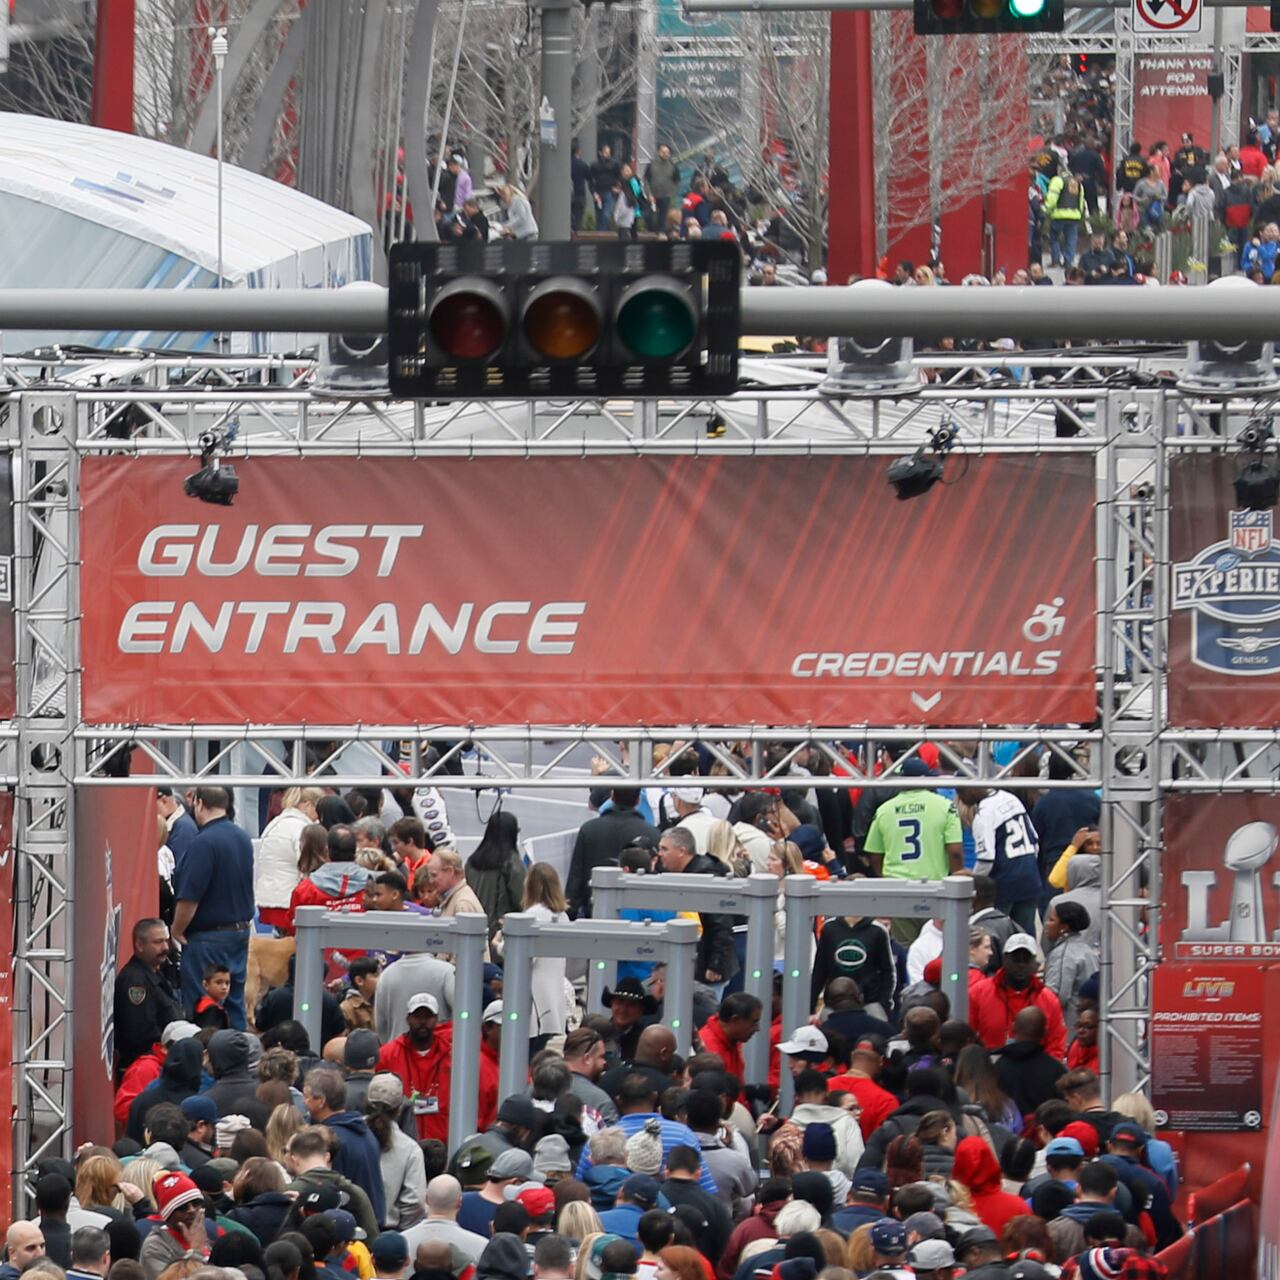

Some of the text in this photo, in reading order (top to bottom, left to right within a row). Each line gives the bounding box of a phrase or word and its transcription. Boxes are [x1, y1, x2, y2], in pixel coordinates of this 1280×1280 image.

[1140, 59, 1186, 69] THANK
[1165, 72, 1196, 83] FOR
[1140, 85, 1208, 96] ATTENDIN
[136, 524, 425, 577] GUEST
[1233, 528, 1268, 551] NFL
[1177, 566, 1280, 595] EXPERIE
[117, 601, 587, 655] ENTRANCE
[790, 650, 1062, 678] CREDENTIALS
[898, 819, 923, 861] 3
[1191, 945, 1280, 956] SUPER BO
[1153, 1012, 1222, 1022] PROHIBITED
